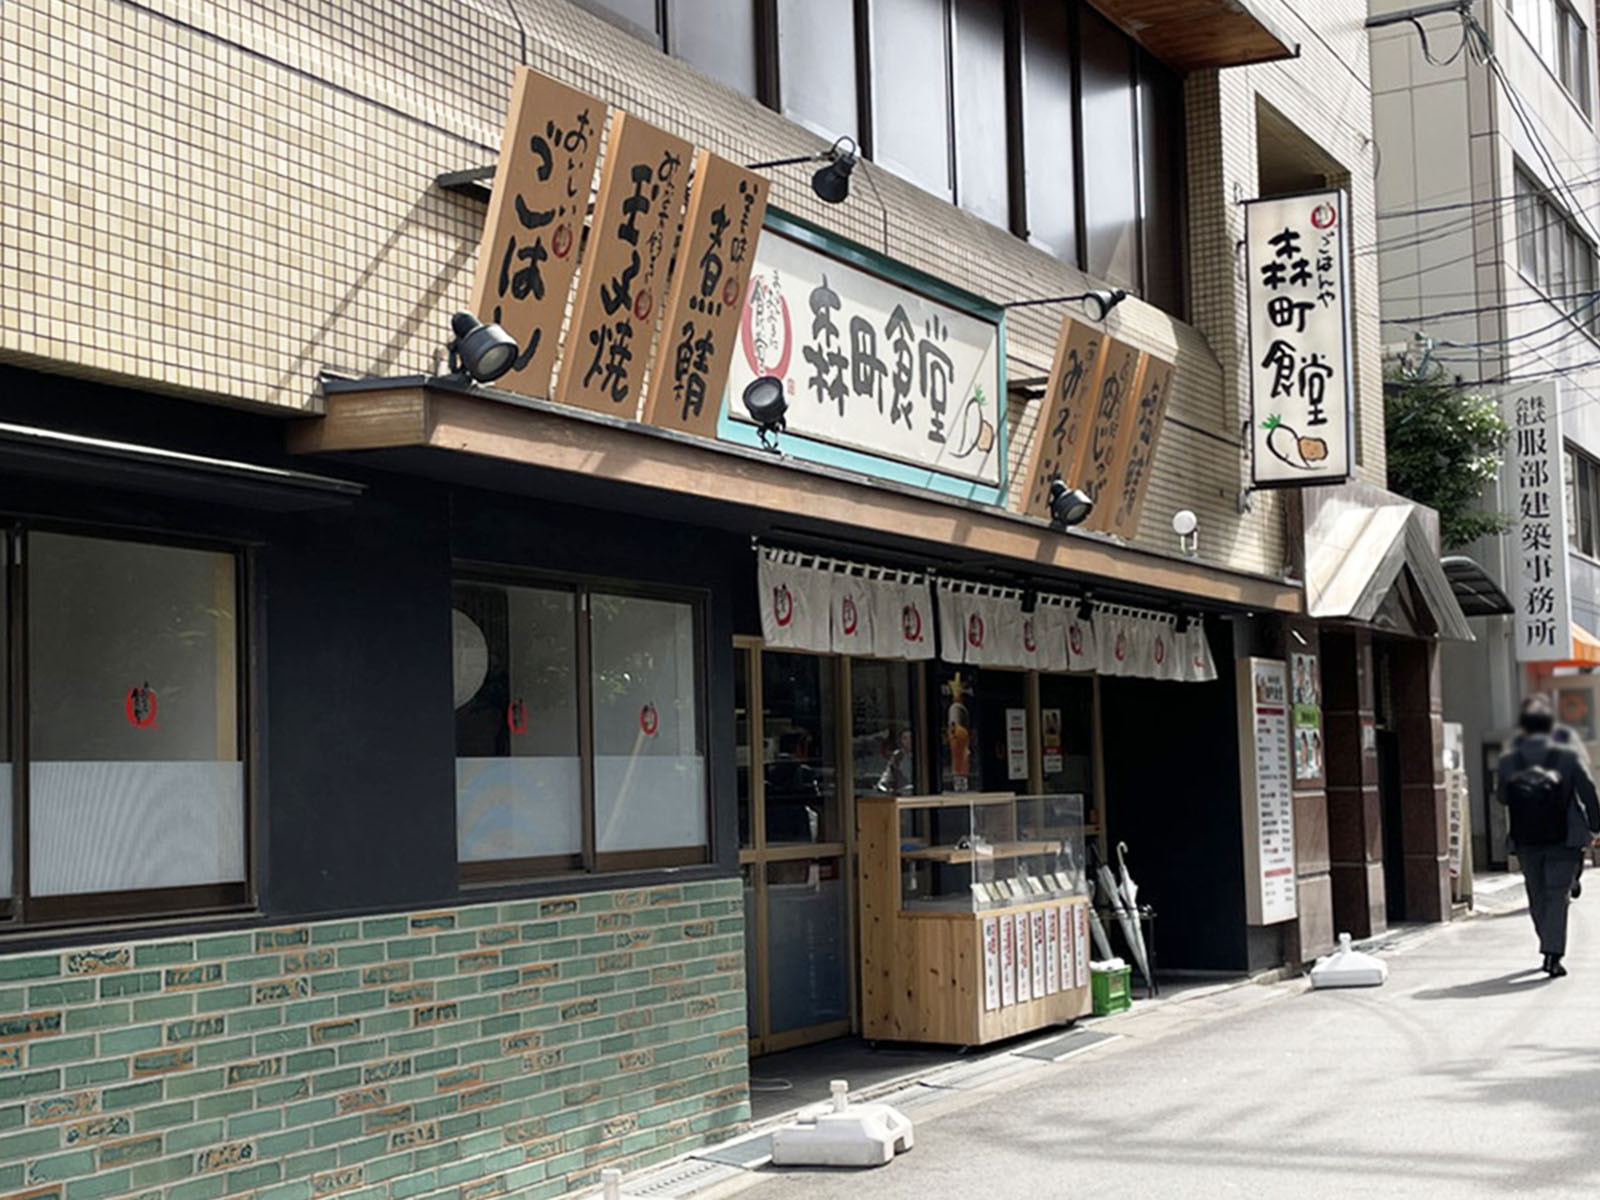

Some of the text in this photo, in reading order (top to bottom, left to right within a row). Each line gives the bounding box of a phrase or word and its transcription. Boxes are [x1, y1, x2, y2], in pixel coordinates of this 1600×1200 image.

[558, 108, 595, 217] おいしい
[583, 164, 660, 403] 玉子焼
[673, 204, 731, 421] 煮鯖
[801, 273, 955, 444] 森町食堂
[1261, 228, 1334, 427] 森町食堂
[1316, 231, 1335, 308] ごはんや
